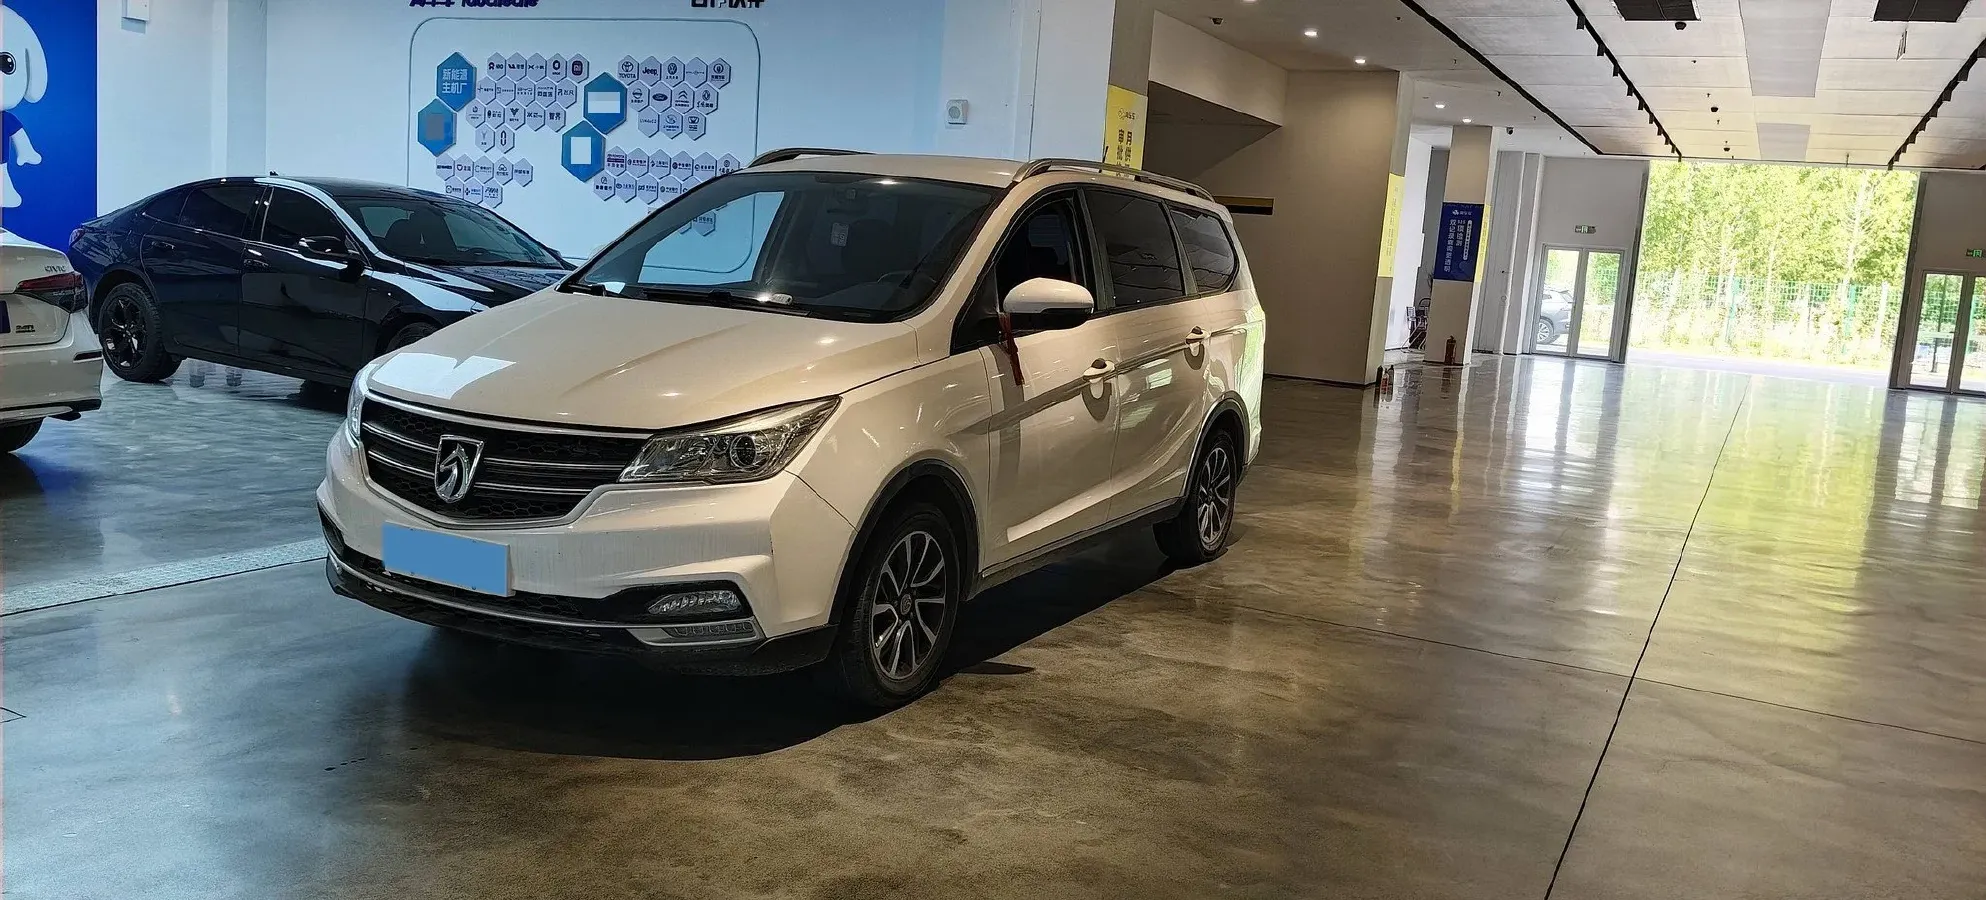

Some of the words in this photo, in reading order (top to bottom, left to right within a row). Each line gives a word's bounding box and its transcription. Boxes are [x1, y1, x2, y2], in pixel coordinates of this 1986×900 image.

[442, 69, 468, 81] 新能源
[442, 82, 468, 94] 主机厂
[45, 265, 66, 273] CIVIC
